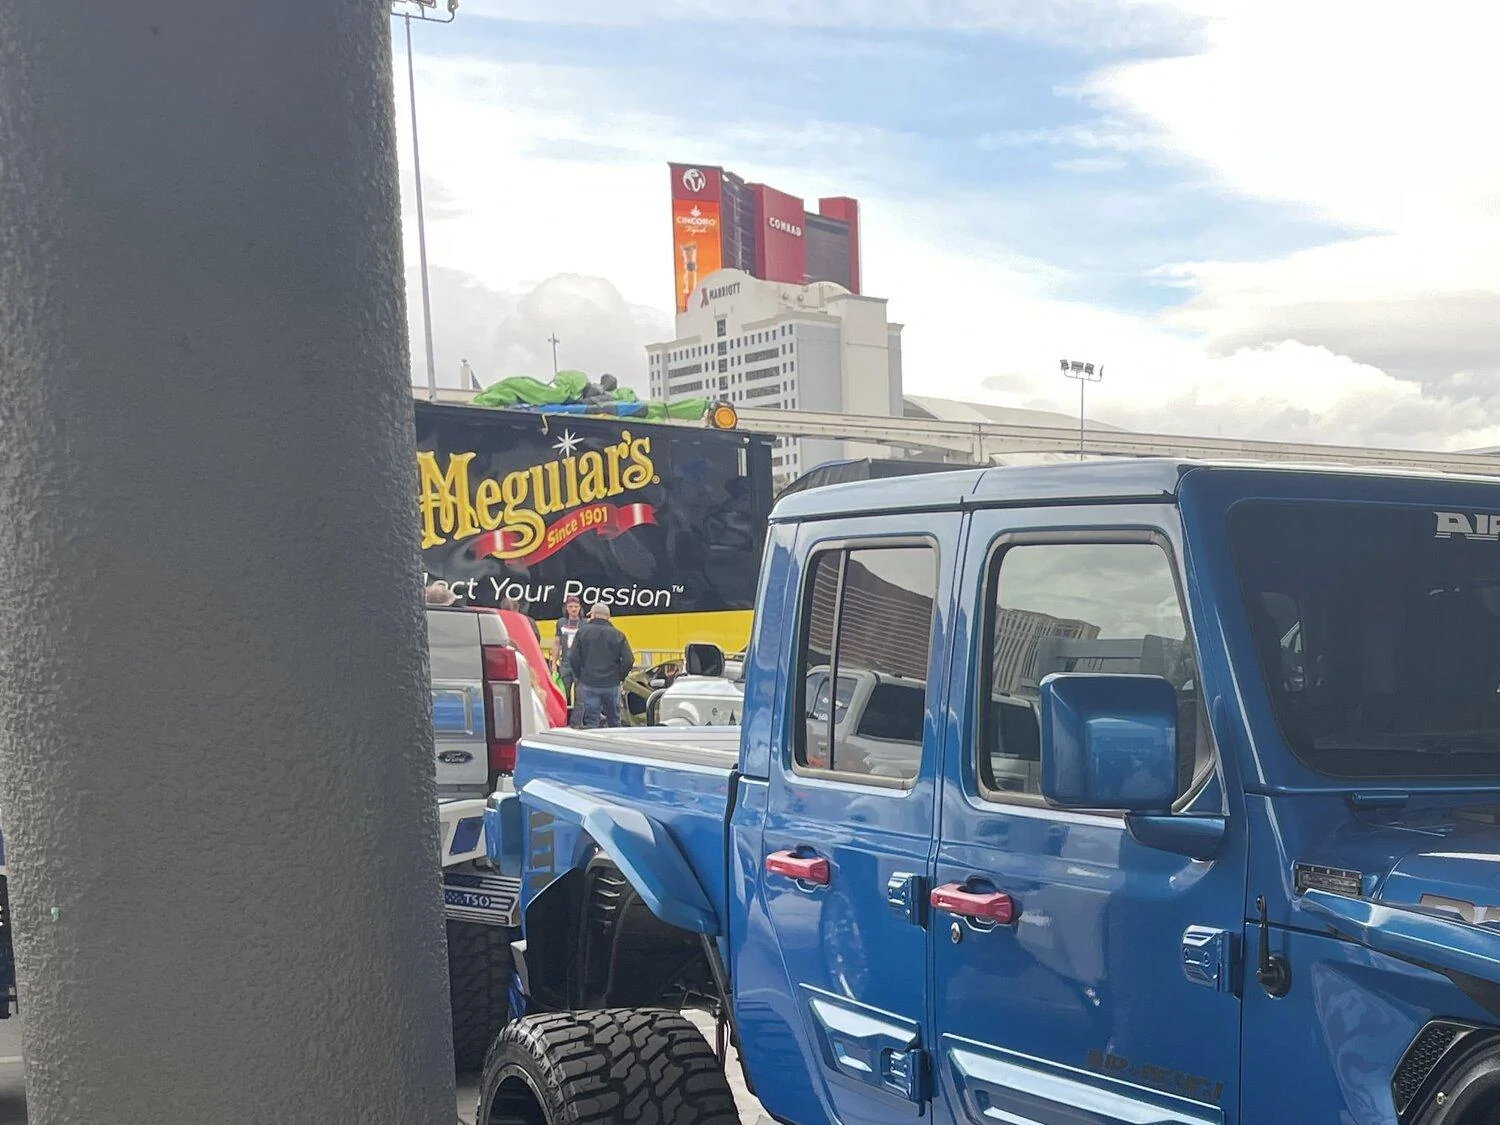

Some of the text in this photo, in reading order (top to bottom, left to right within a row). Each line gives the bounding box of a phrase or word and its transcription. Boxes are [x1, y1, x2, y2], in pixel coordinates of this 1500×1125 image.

[768, 217, 802, 237] CONRAD
[709, 282, 741, 300] MARRIOTT
[417, 430, 656, 559] Meguiar's
[547, 506, 608, 550] Since 1901
[490, 576, 555, 603] Your
